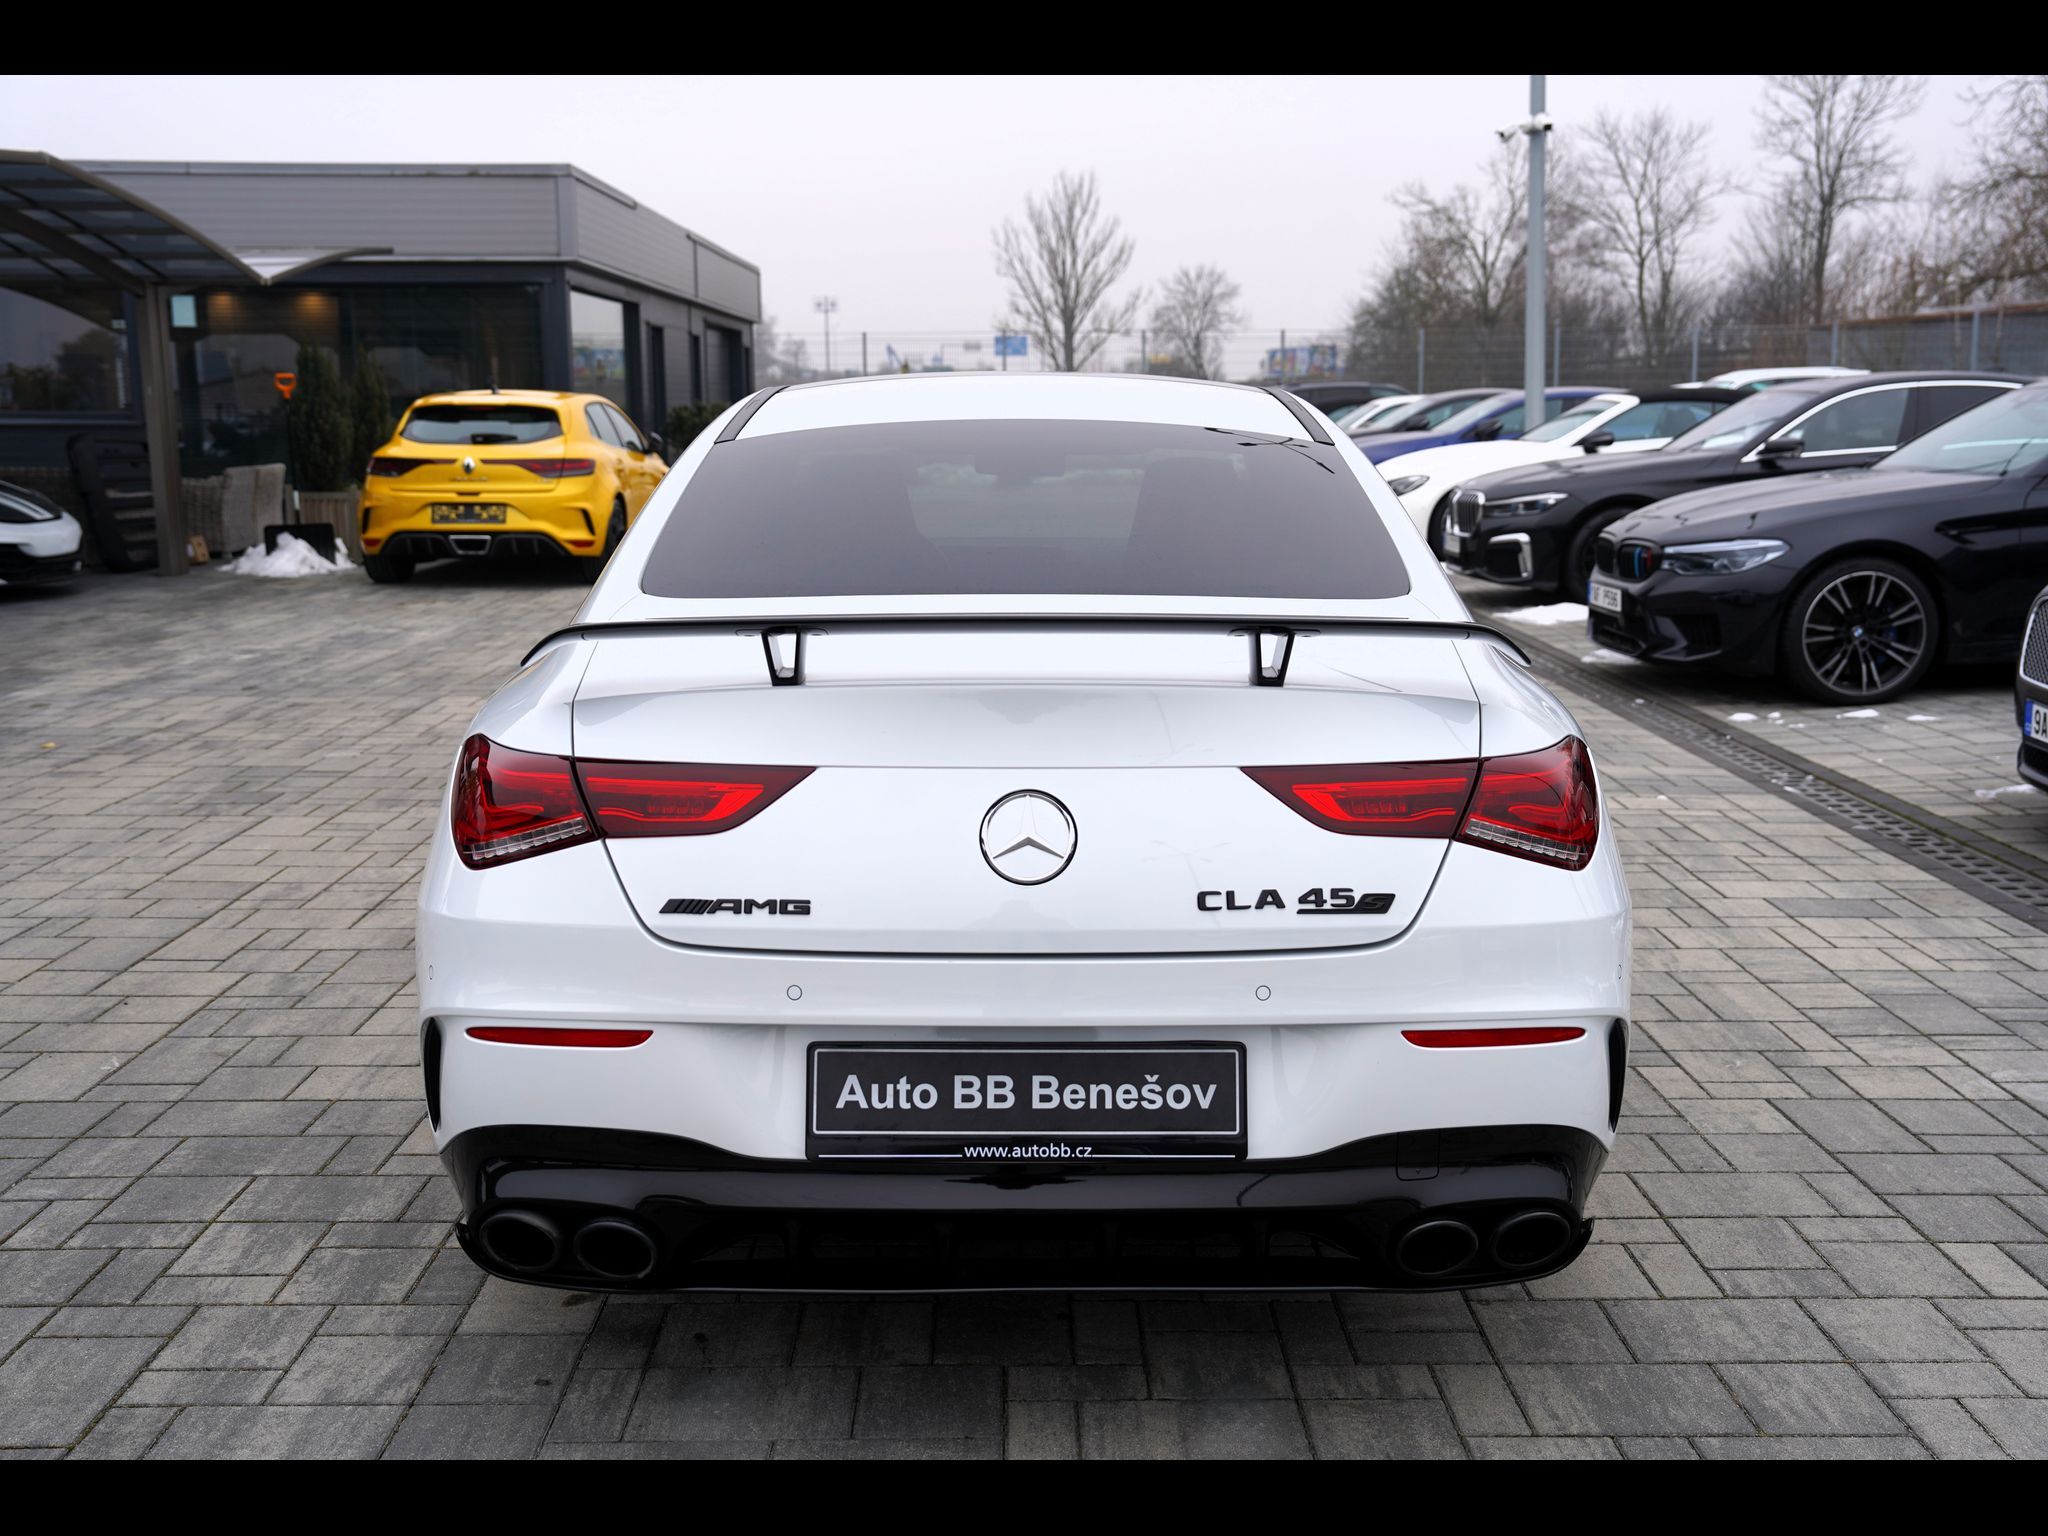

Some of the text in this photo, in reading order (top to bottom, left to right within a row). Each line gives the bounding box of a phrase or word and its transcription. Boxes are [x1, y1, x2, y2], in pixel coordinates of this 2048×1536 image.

[706, 899, 811, 915] AMG
[1197, 889, 1286, 911] CLA
[836, 1074, 1218, 1110] Auto BB Benešov
[964, 1144, 1093, 1159] www.autobb.cz
